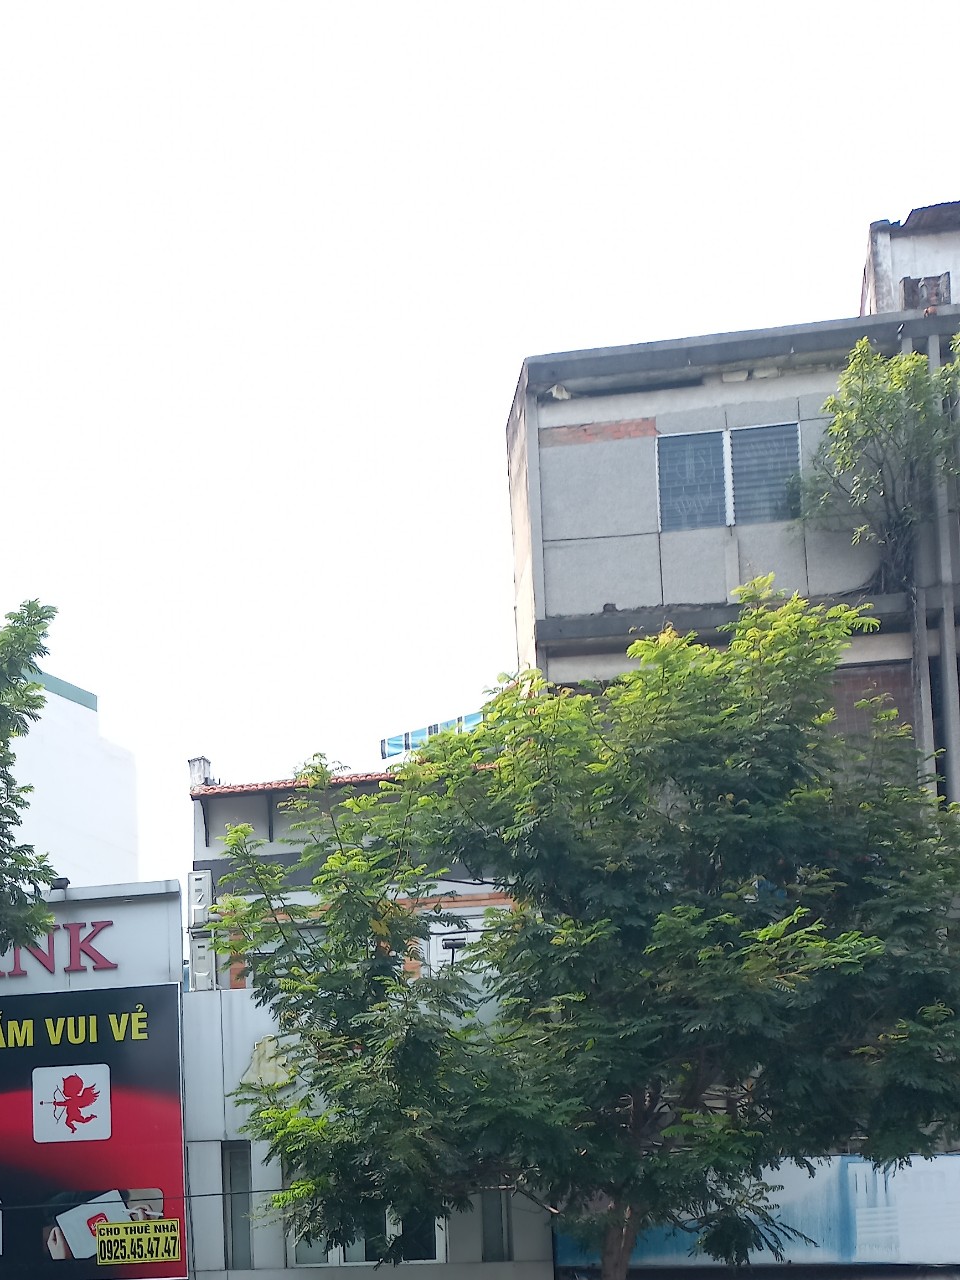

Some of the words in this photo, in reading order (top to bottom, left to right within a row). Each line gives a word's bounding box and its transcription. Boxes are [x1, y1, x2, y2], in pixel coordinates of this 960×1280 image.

[44, 1014, 98, 1046] VUI
[108, 1003, 150, 1042] VẺ
[99, 1228, 121, 1237] CHO
[124, 1224, 151, 1235] THUÊ
[154, 1222, 177, 1233] NHÀ
[99, 1235, 178, 1261] 0925.45.47.47
